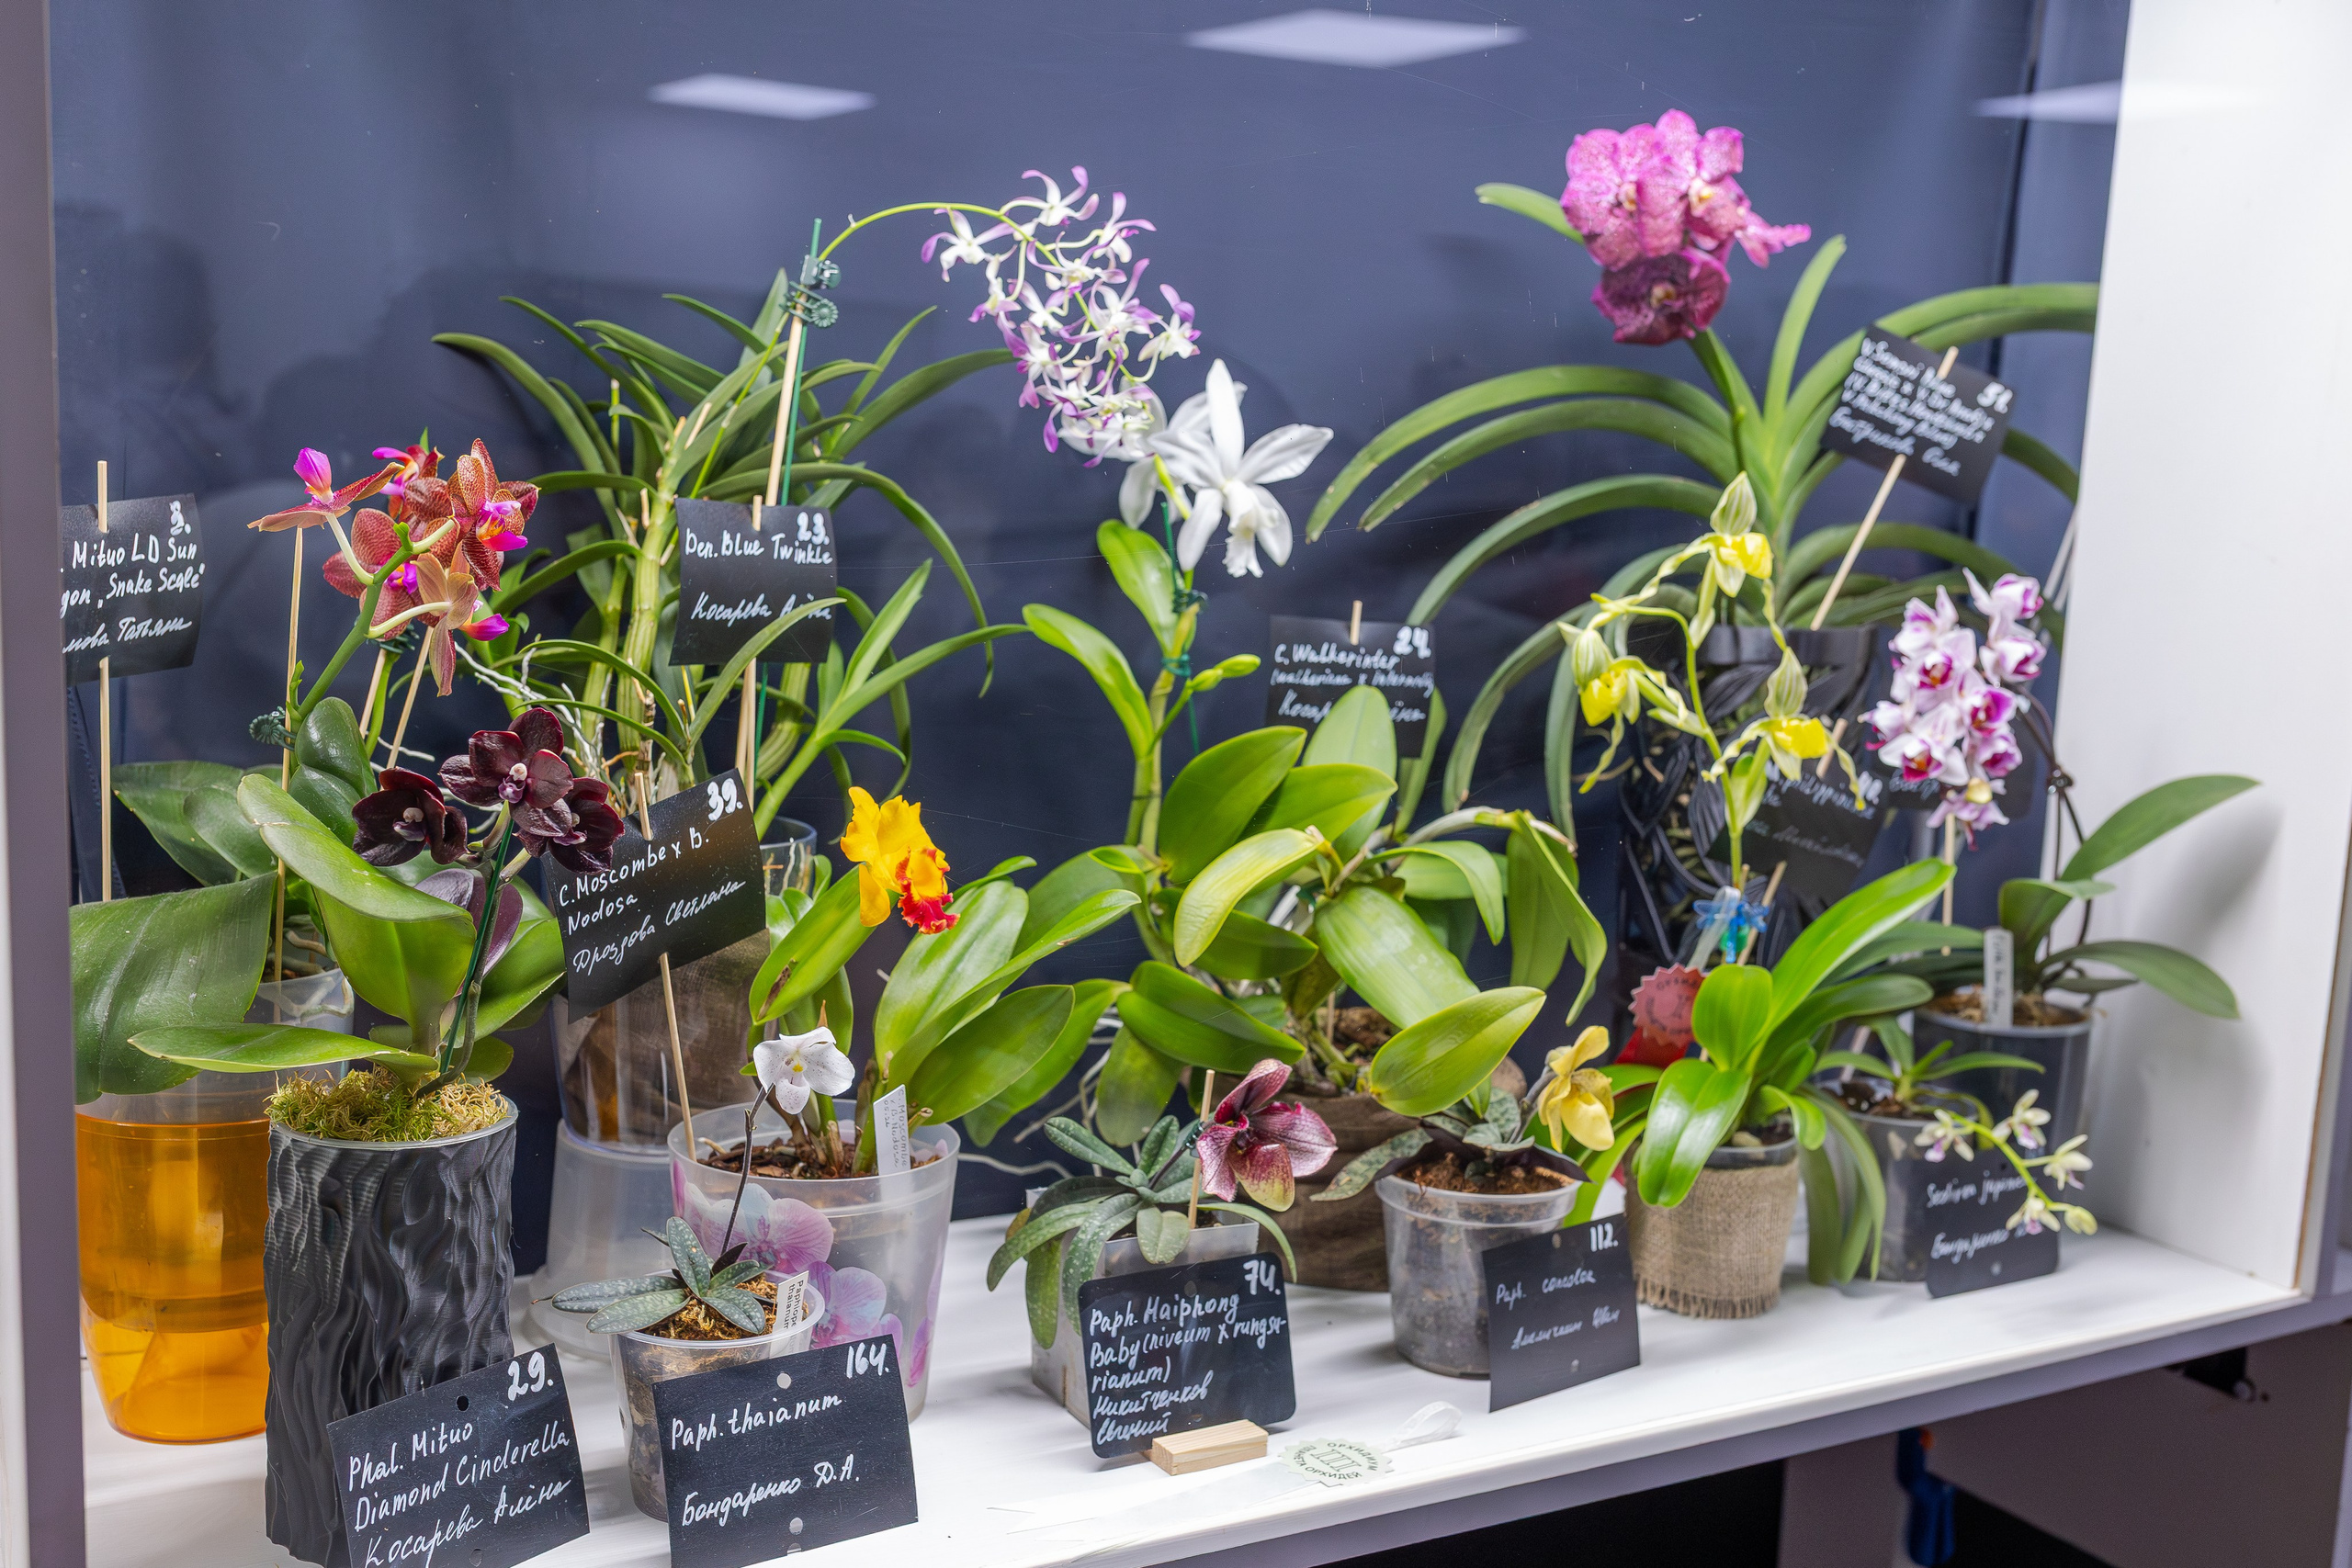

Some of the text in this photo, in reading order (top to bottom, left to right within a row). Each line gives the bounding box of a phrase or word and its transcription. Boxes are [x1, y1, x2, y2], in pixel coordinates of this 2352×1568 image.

[73, 539, 126, 570] Mituo
[167, 536, 198, 562] Sun
[771, 533, 833, 565] Twinkle
[707, 778, 743, 821] 39.
[689, 827, 710, 849] B.
[568, 893, 638, 935] Nodosa
[665, 880, 747, 926] Светлана
[1589, 1223, 1619, 1252] 112.
[1243, 1259, 1282, 1295] 74.
[1144, 1293, 1239, 1326] Haiphong
[507, 1351, 554, 1401] 29.
[846, 1342, 889, 1379] 164.
[1091, 1356, 1171, 1393] rianum)
[728, 1395, 842, 1435] thaianum
[349, 1423, 473, 1491] Phal. Mituo
[355, 1420, 570, 1532] Diamond Cinderella
[682, 1477, 801, 1527] Бондаренко
[365, 1505, 483, 1568] Косарева
